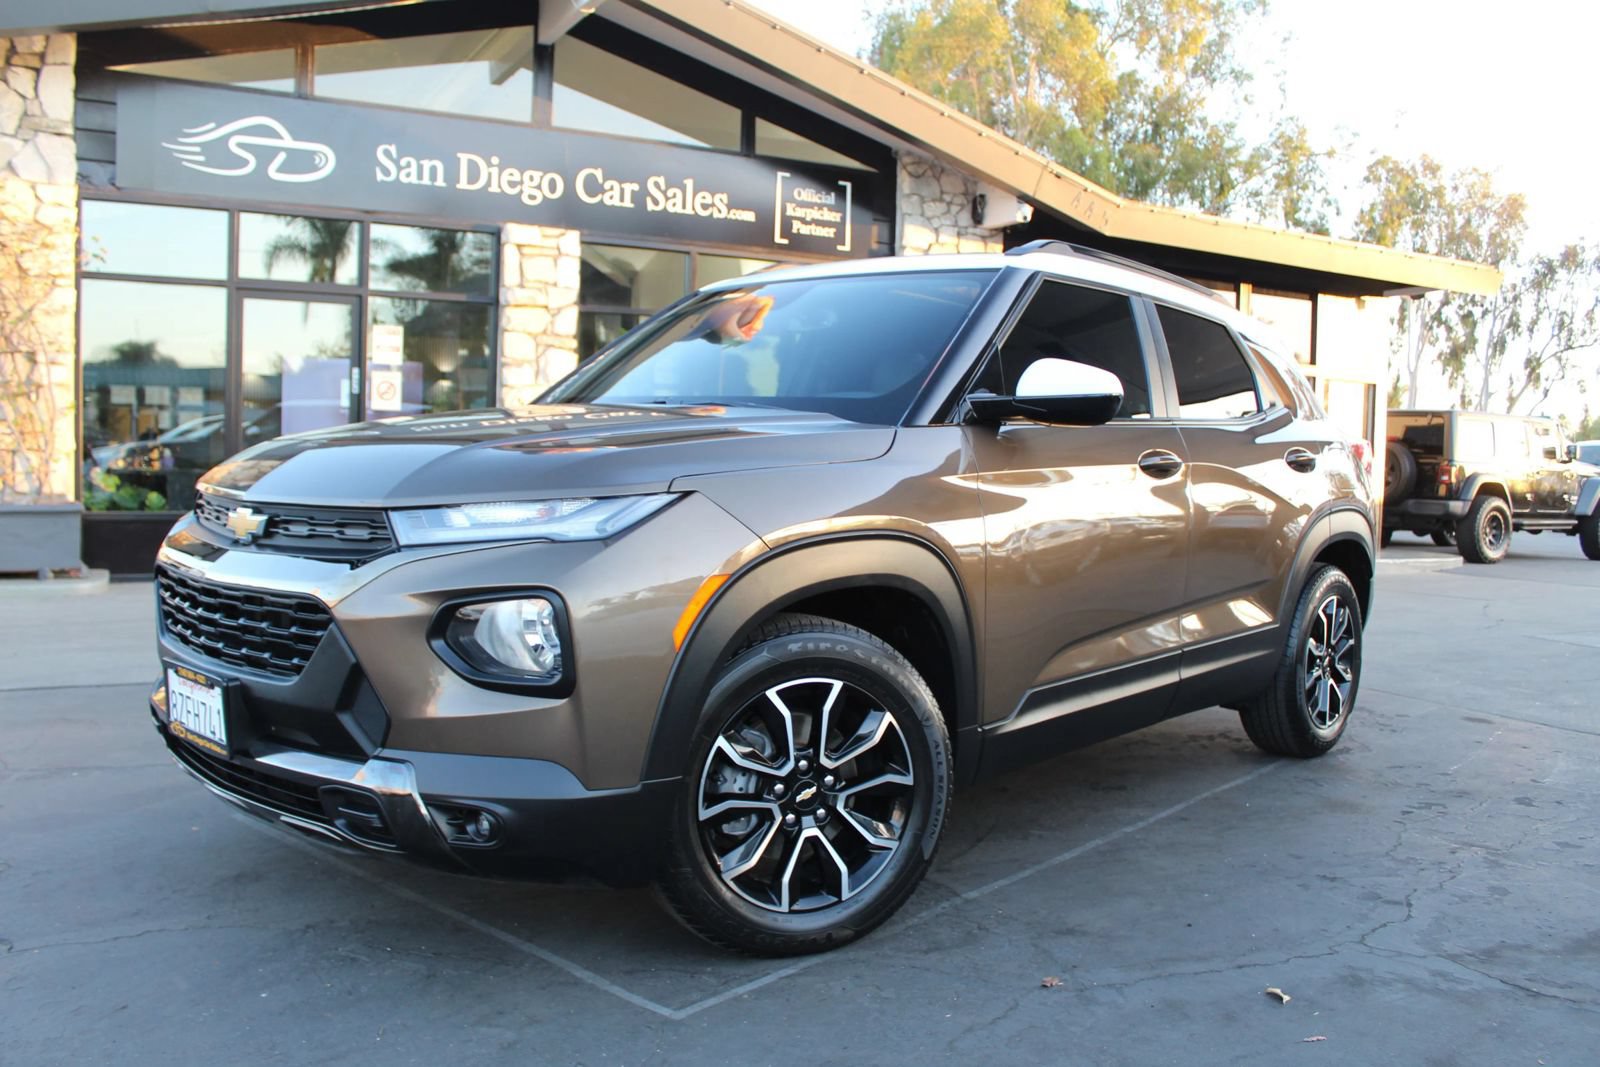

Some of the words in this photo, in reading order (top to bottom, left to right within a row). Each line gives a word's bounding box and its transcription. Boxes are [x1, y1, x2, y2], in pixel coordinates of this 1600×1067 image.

[375, 143, 447, 187] San
[455, 153, 565, 206] Diego
[575, 168, 640, 208] Car
[793, 187, 836, 205] Official
[791, 219, 837, 238] Partner
[171, 690, 226, 743] 8ZFH741
